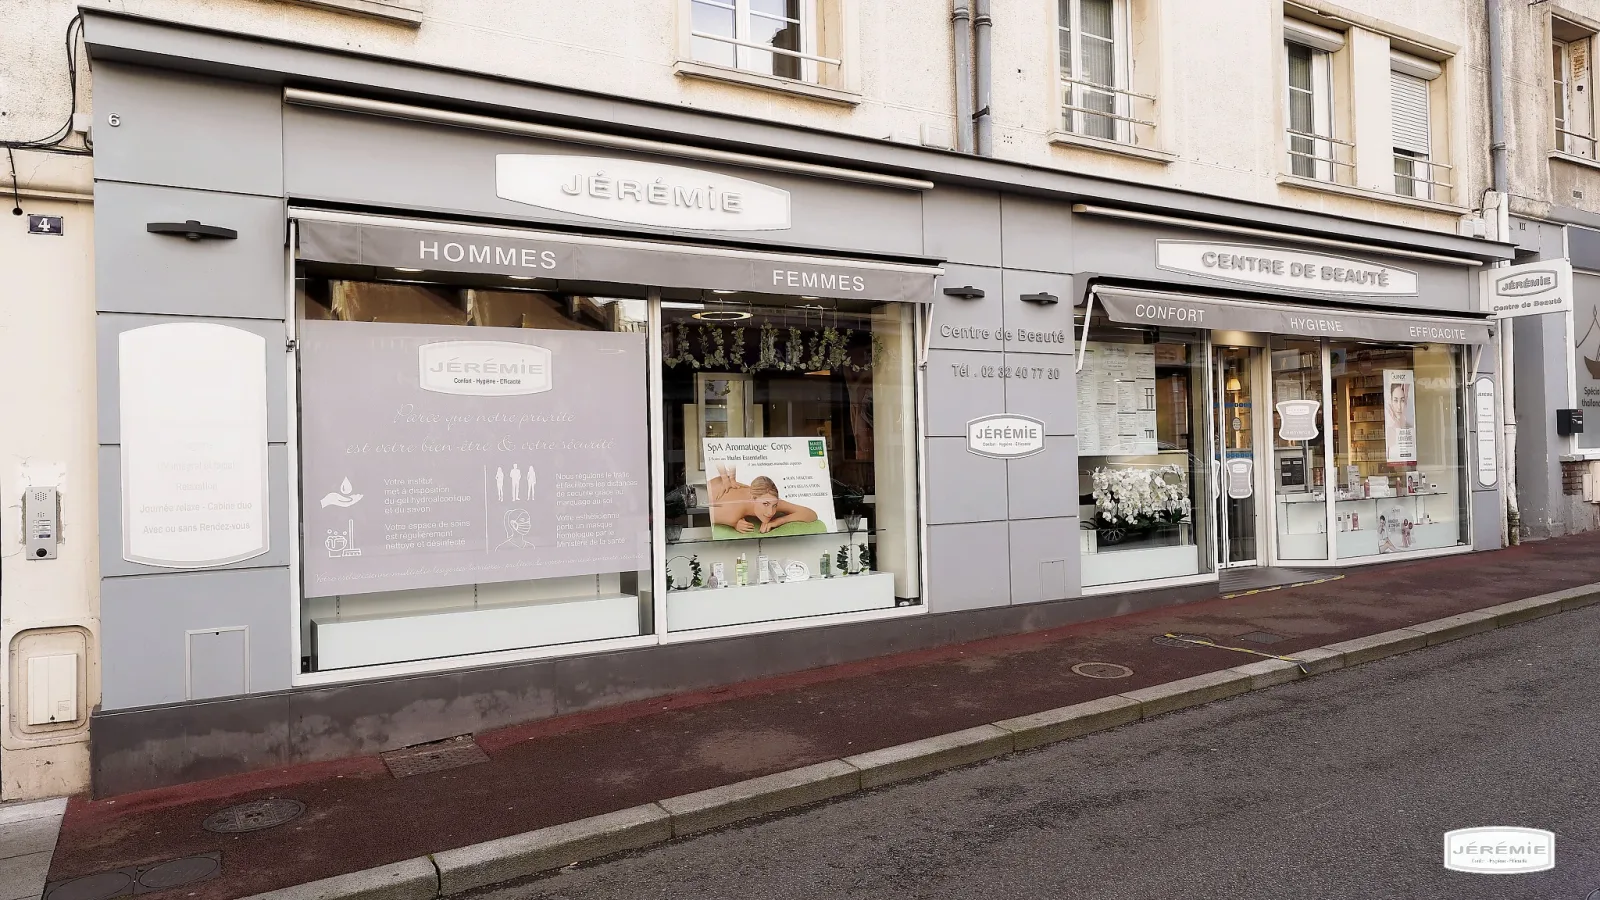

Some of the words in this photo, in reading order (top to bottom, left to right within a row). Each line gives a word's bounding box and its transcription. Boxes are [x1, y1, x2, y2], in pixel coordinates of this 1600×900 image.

[108, 113, 121, 127] 6
[38, 217, 51, 232] 4
[419, 239, 557, 270] HOMMES
[1201, 251, 1285, 276] CENTRE
[1290, 261, 1316, 278] DE
[1321, 265, 1389, 287] BEAUTÉ
[772, 269, 866, 292] FEMMES
[1493, 304, 1520, 312] Centre
[1533, 297, 1562, 307] Beauté
[1135, 304, 1206, 322] CONFORT
[1290, 317, 1344, 332] HYGIENE
[940, 324, 990, 339] Centre
[995, 327, 1013, 341] de
[1017, 328, 1065, 344] Beauté
[1409, 326, 1467, 340] EFFICACITE
[981, 366, 994, 378] 02
[998, 366, 1013, 379] 32
[1015, 367, 1028, 379] 40
[1031, 367, 1044, 379] 77
[1047, 367, 1060, 380] 30
[393, 403, 441, 424] Parce
[445, 413, 473, 431] que
[476, 412, 517, 423] notre
[518, 411, 576, 430] priorité
[346, 442, 373, 454] est
[375, 442, 418, 453] votre
[497, 434, 516, 452] &
[521, 439, 558, 451] votre
[562, 437, 616, 450] sécurité
[707, 442, 724, 454] SpA
[770, 442, 792, 453] Corps
[383, 477, 405, 486] Votre
[407, 476, 433, 485] institut
[555, 472, 574, 480] Nous
[384, 487, 400, 495] met
[408, 485, 450, 496] disposition
[140, 503, 174, 514] Journée
[175, 502, 200, 512] relaxe
[207, 501, 235, 511] Cabine
[237, 501, 253, 511] duo
[384, 497, 395, 505] du
[396, 496, 409, 506] gel
[394, 506, 405, 514] du
[556, 513, 575, 522] Votre
[143, 525, 164, 535] Avec
[165, 525, 176, 533] ou
[178, 524, 198, 533] sans
[199, 522, 250, 532] Rendez-vous
[384, 523, 406, 531] Votre
[408, 522, 437, 531] espace
[438, 520, 449, 528] de
[450, 519, 471, 528] soins
[556, 522, 574, 532] porte
[385, 533, 398, 541] est
[589, 538, 599, 546] de
[416, 540, 425, 548] et
